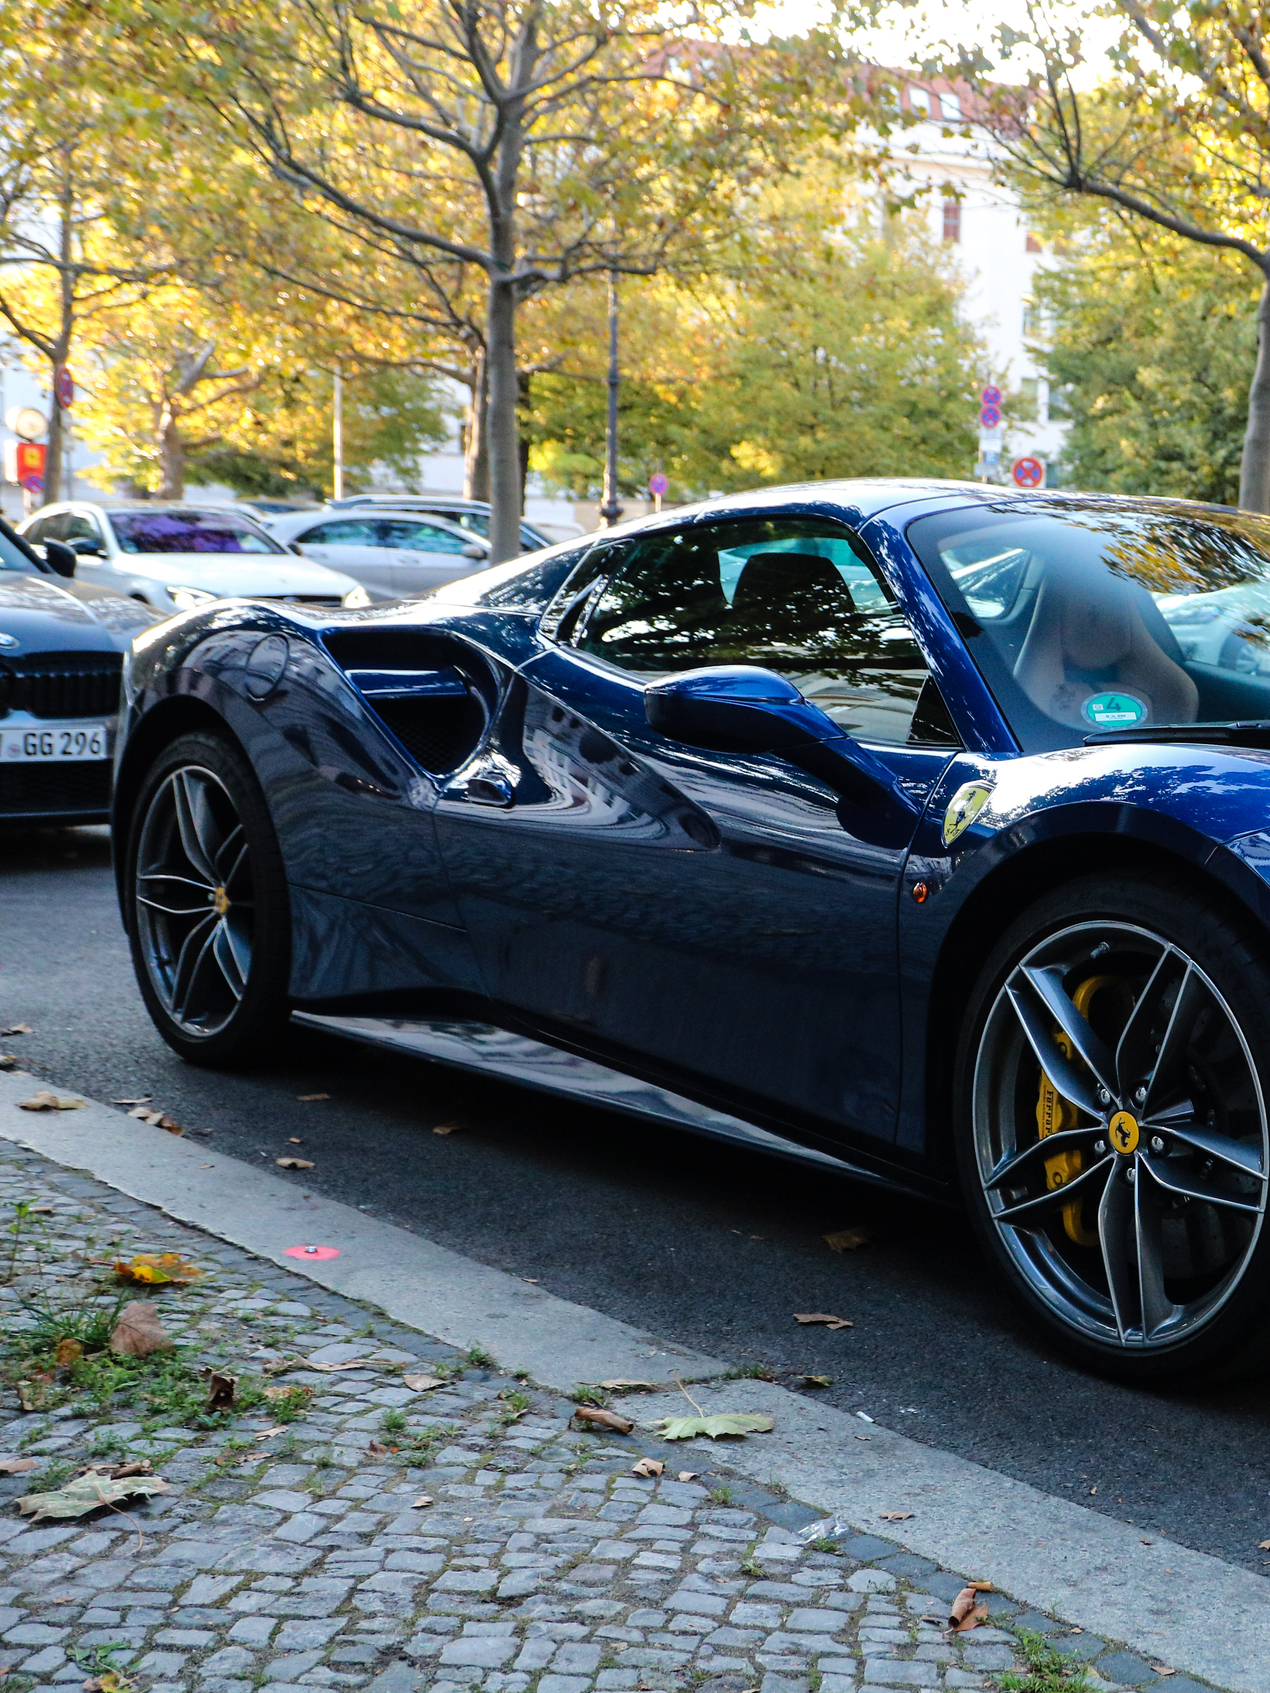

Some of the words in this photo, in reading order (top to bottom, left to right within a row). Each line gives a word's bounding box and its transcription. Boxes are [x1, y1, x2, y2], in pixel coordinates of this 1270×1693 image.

[1106, 697, 1121, 711] 4
[24, 732, 53, 756] GG
[60, 732, 101, 756] 296
